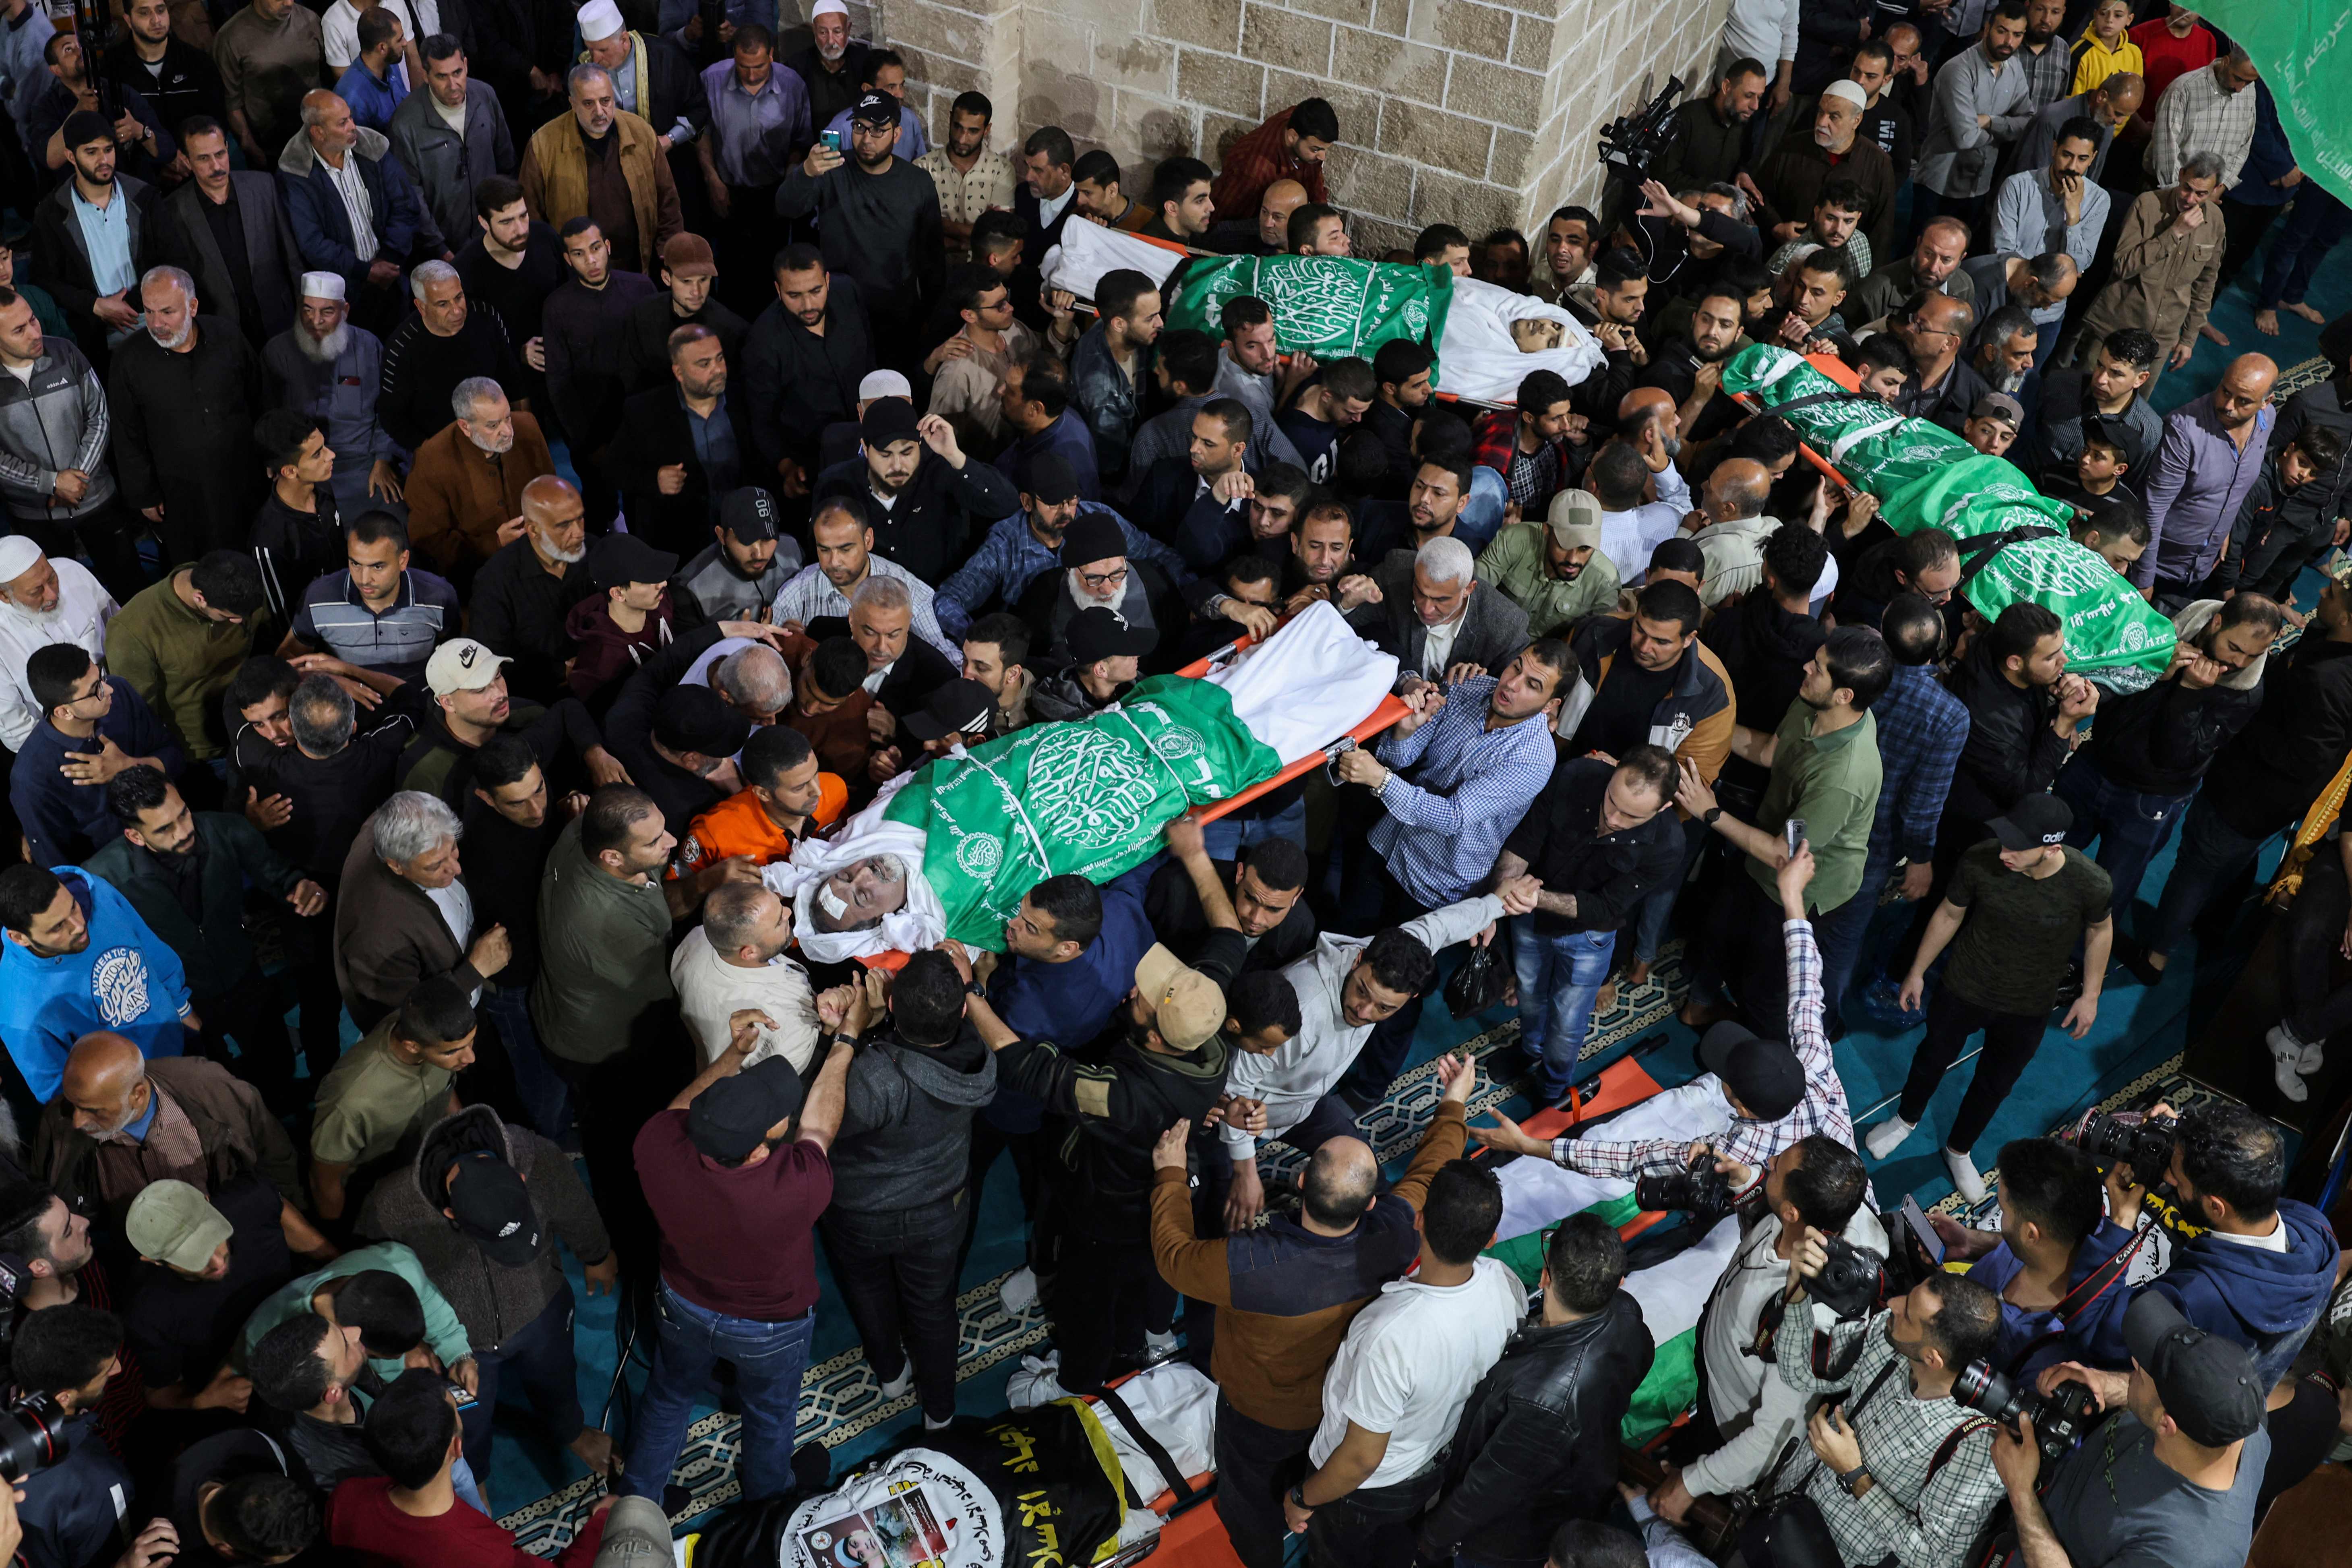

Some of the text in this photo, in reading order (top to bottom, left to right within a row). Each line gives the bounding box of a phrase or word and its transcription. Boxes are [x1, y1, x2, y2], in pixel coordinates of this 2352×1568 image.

[459, 645, 476, 661] NIKE
[93, 947, 126, 997] AUTHENTIC
[1733, 1185, 1762, 1205] Canon
[2116, 1233, 2143, 1264] Canon
[1962, 1417, 1996, 1433] Canon
[611, 1541, 652, 1556] FILA
